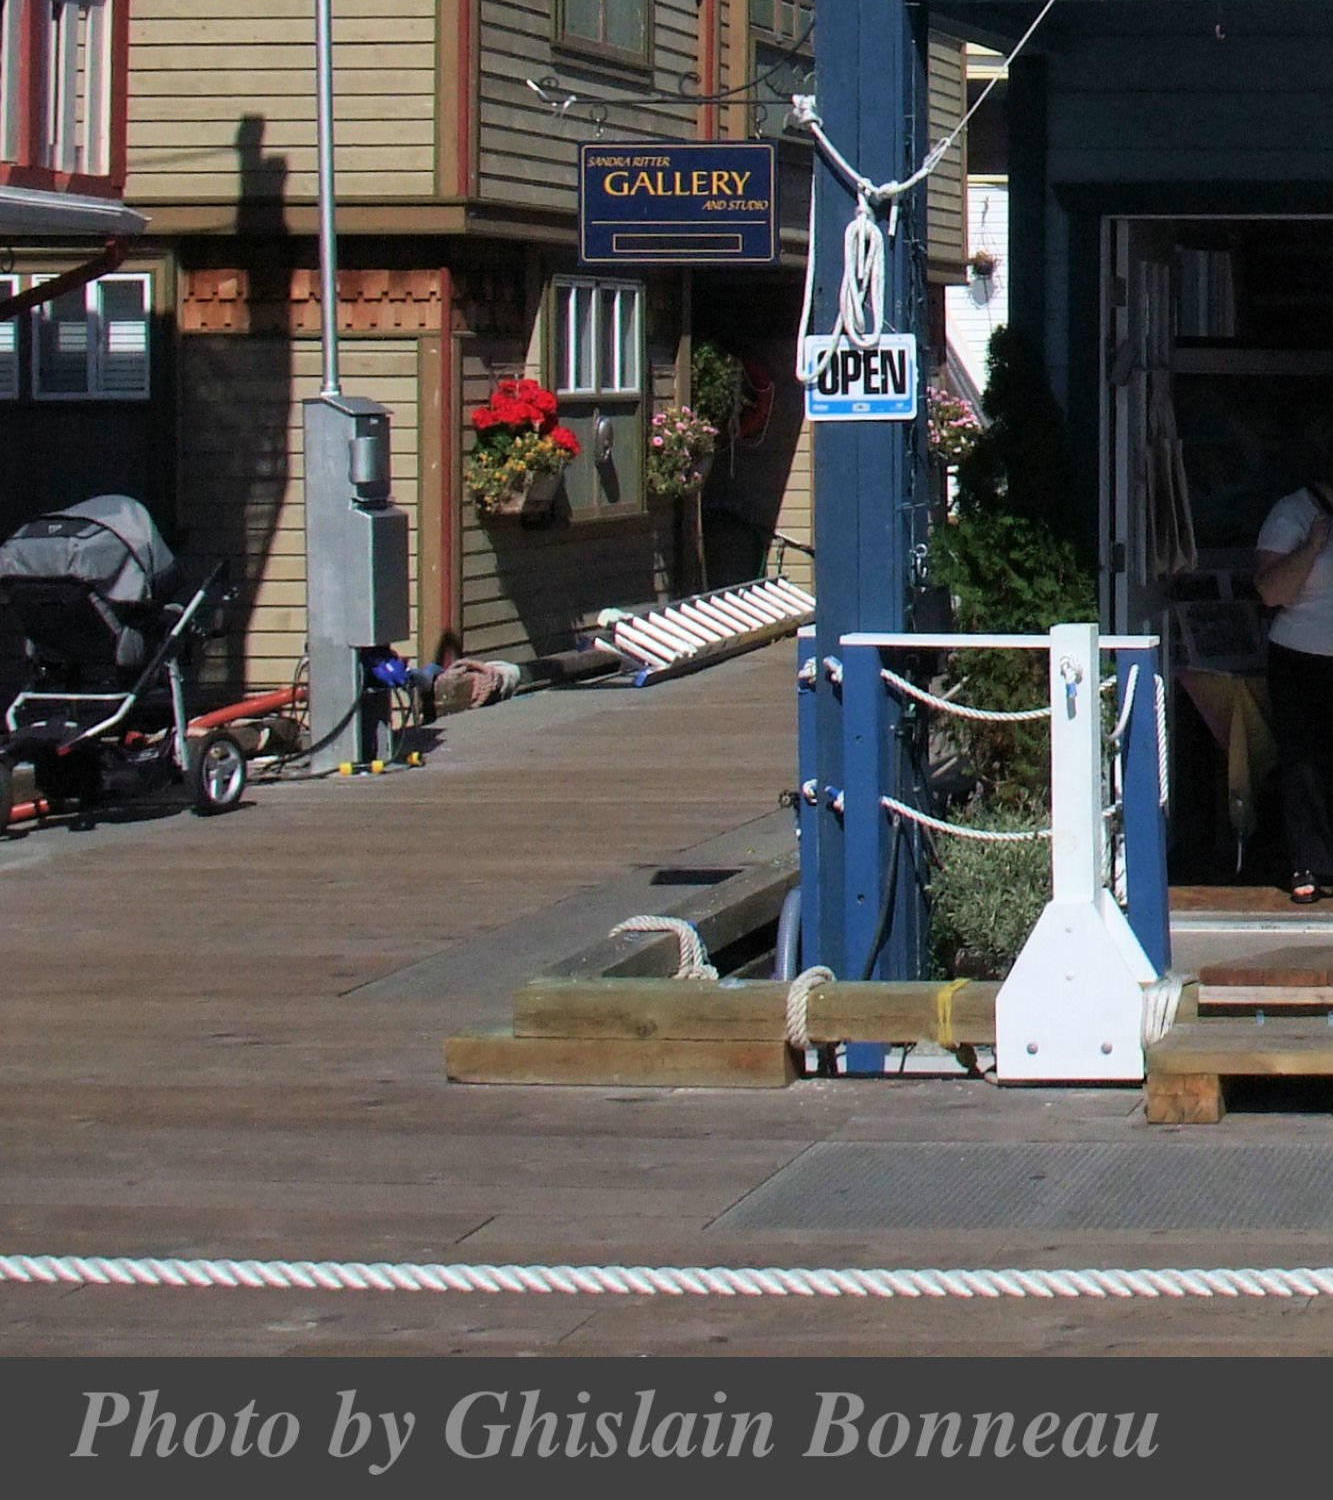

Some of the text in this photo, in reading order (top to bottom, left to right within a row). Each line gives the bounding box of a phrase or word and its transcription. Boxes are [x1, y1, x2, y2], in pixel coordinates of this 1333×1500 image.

[587, 156, 671, 168] SANDRA RITTER
[604, 171, 752, 196] GALLERY
[702, 200, 769, 211] AND STUDIO
[817, 349, 907, 396] OPEN
